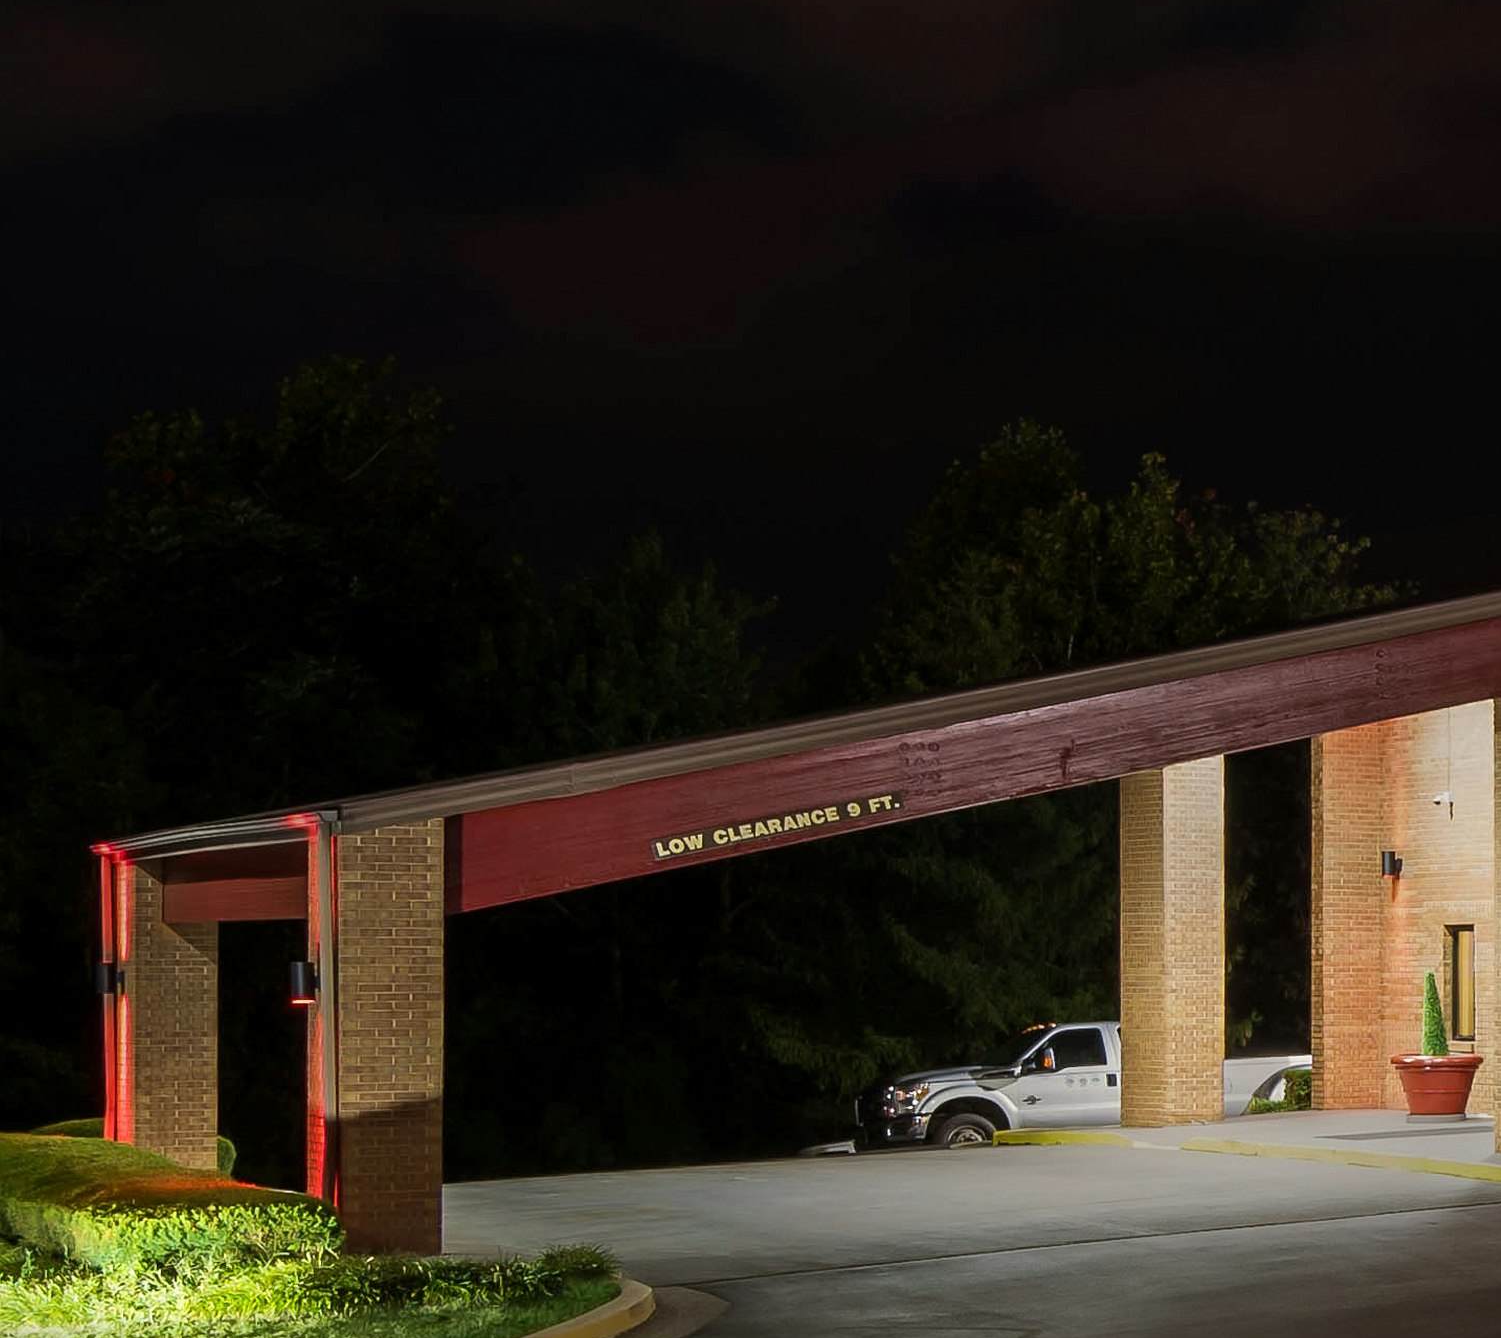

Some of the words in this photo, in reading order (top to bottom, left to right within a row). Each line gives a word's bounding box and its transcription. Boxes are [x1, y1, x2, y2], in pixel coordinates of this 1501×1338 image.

[656, 834, 704, 857] LOW
[713, 807, 840, 845] CLEARANCE
[847, 802, 861, 817] 9
[868, 795, 900, 814] FT.
